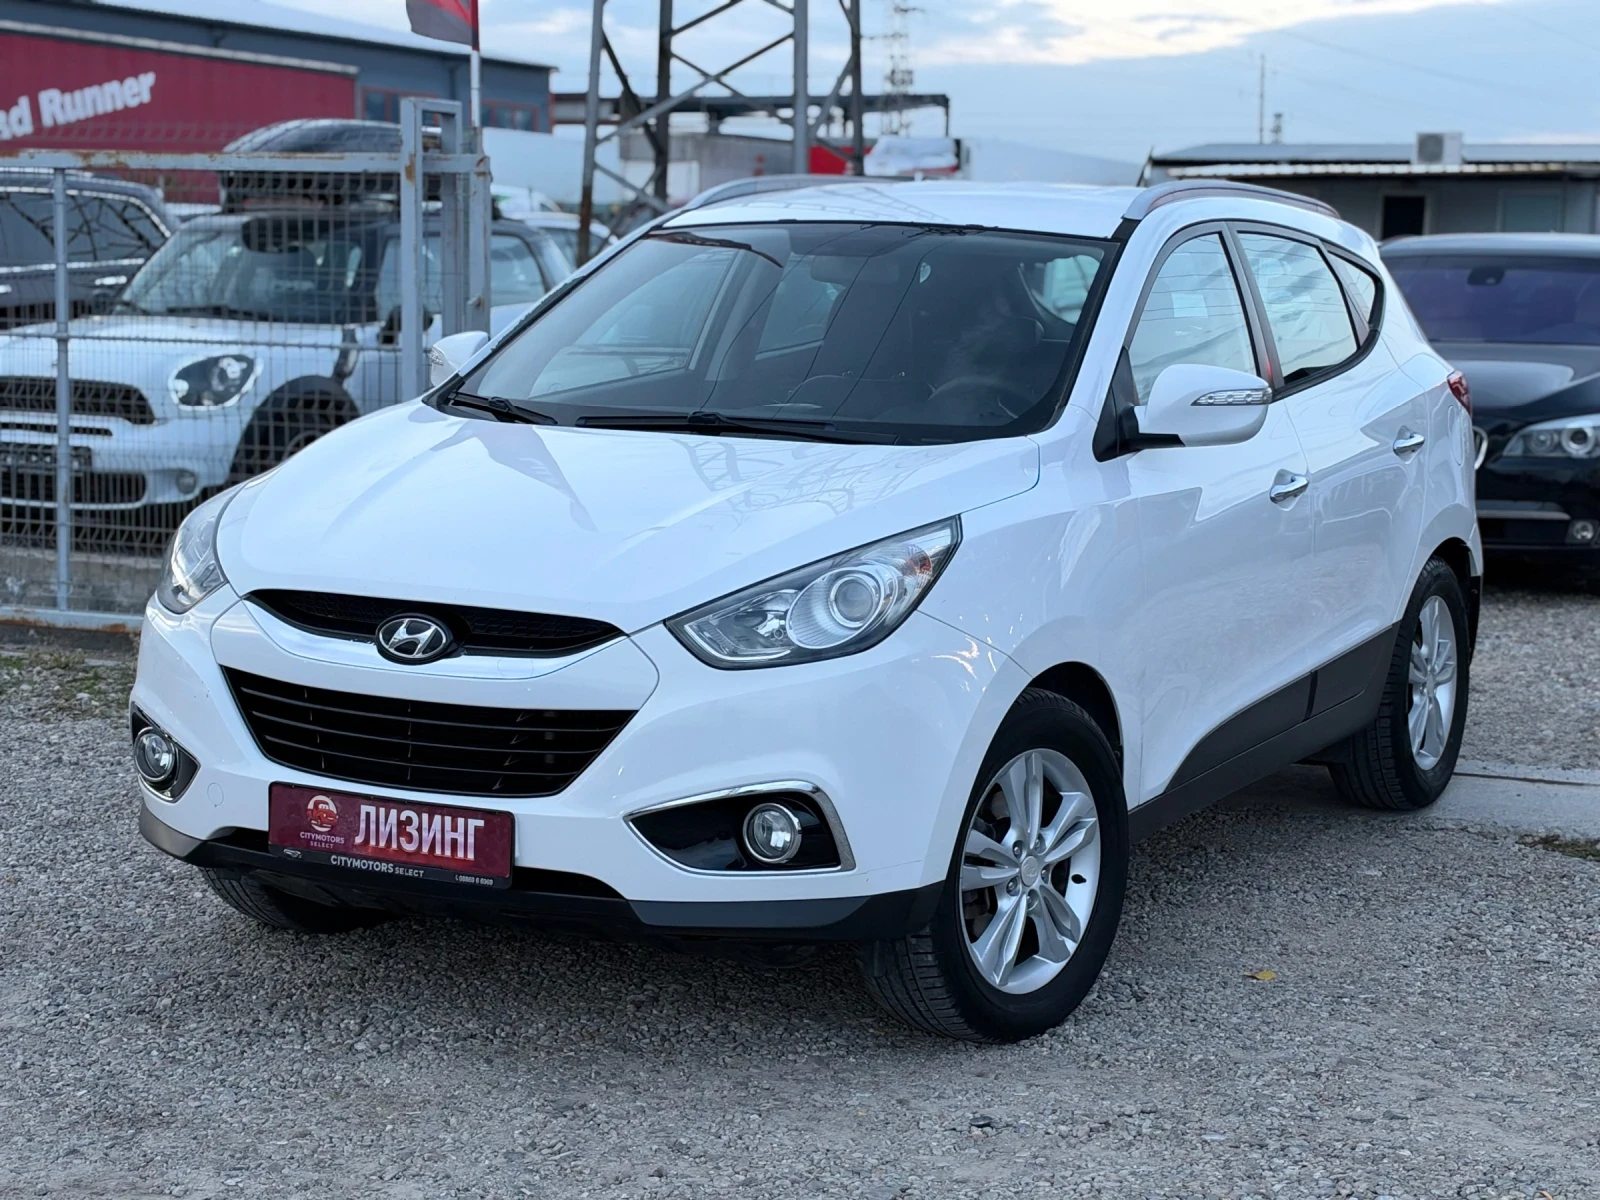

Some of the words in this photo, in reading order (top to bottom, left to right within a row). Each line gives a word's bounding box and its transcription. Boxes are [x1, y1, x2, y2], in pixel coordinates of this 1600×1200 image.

[38, 71, 156, 127] Runner
[299, 831, 345, 844] CITYMOTORS
[354, 804, 485, 861] ЛИЗИНГ
[310, 841, 334, 849] SELECT
[330, 855, 394, 874] CITYMOTORS
[395, 867, 425, 878] SELECT
